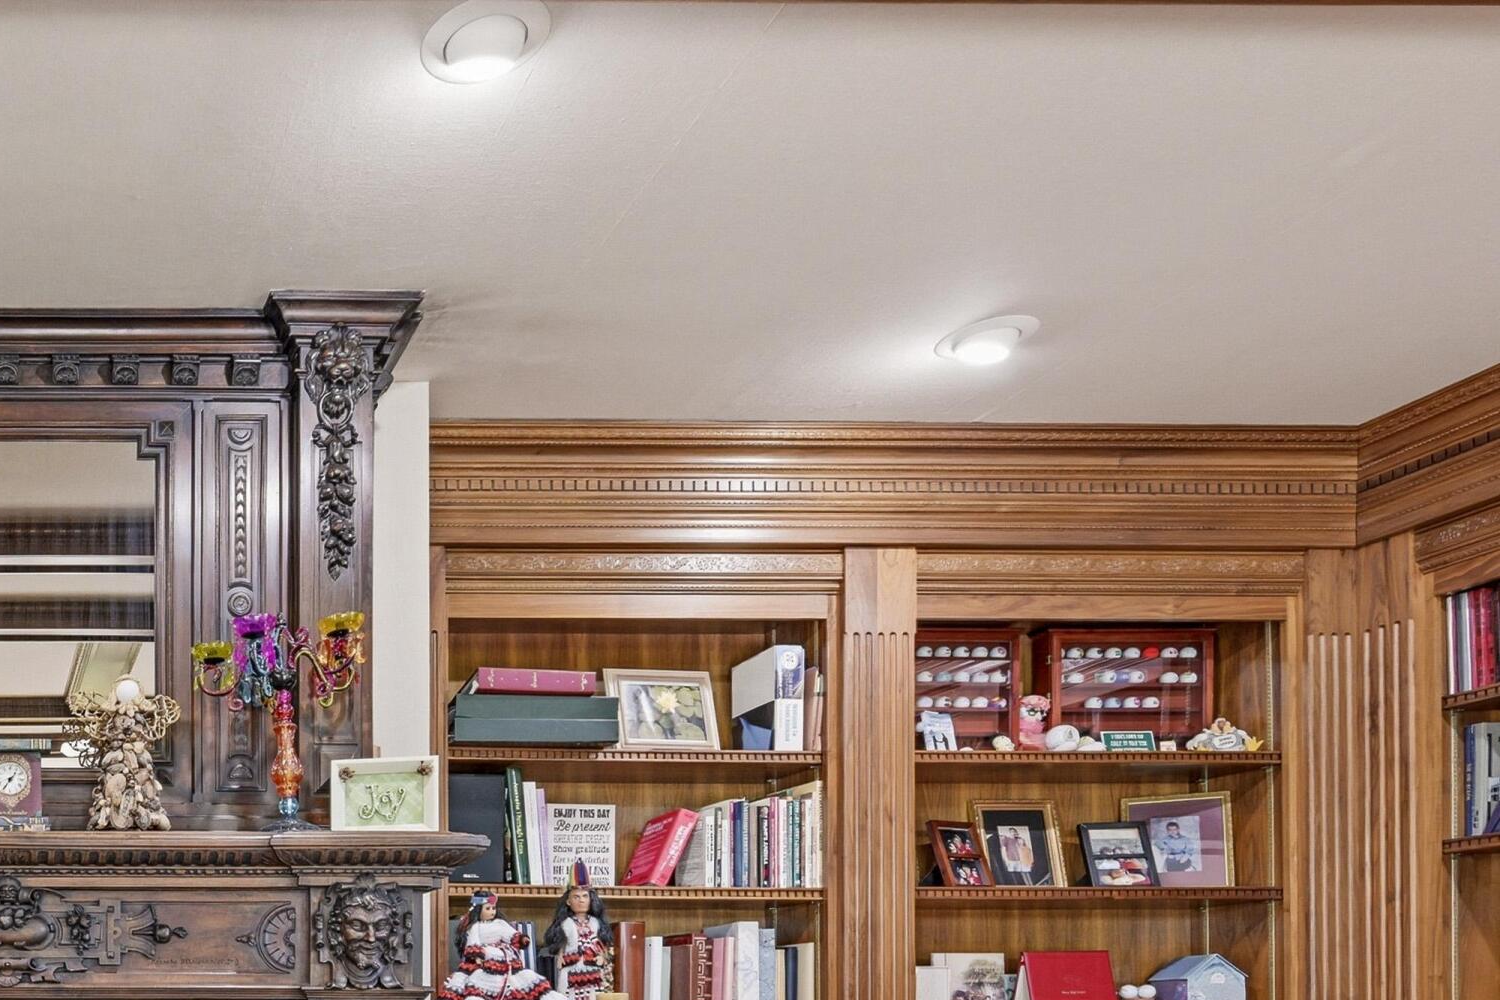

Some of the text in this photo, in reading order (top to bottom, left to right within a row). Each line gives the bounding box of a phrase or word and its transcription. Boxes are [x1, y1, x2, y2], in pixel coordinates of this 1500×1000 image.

[553, 808, 610, 818] ENJOY THIS DAY
[553, 819, 571, 831] Be
